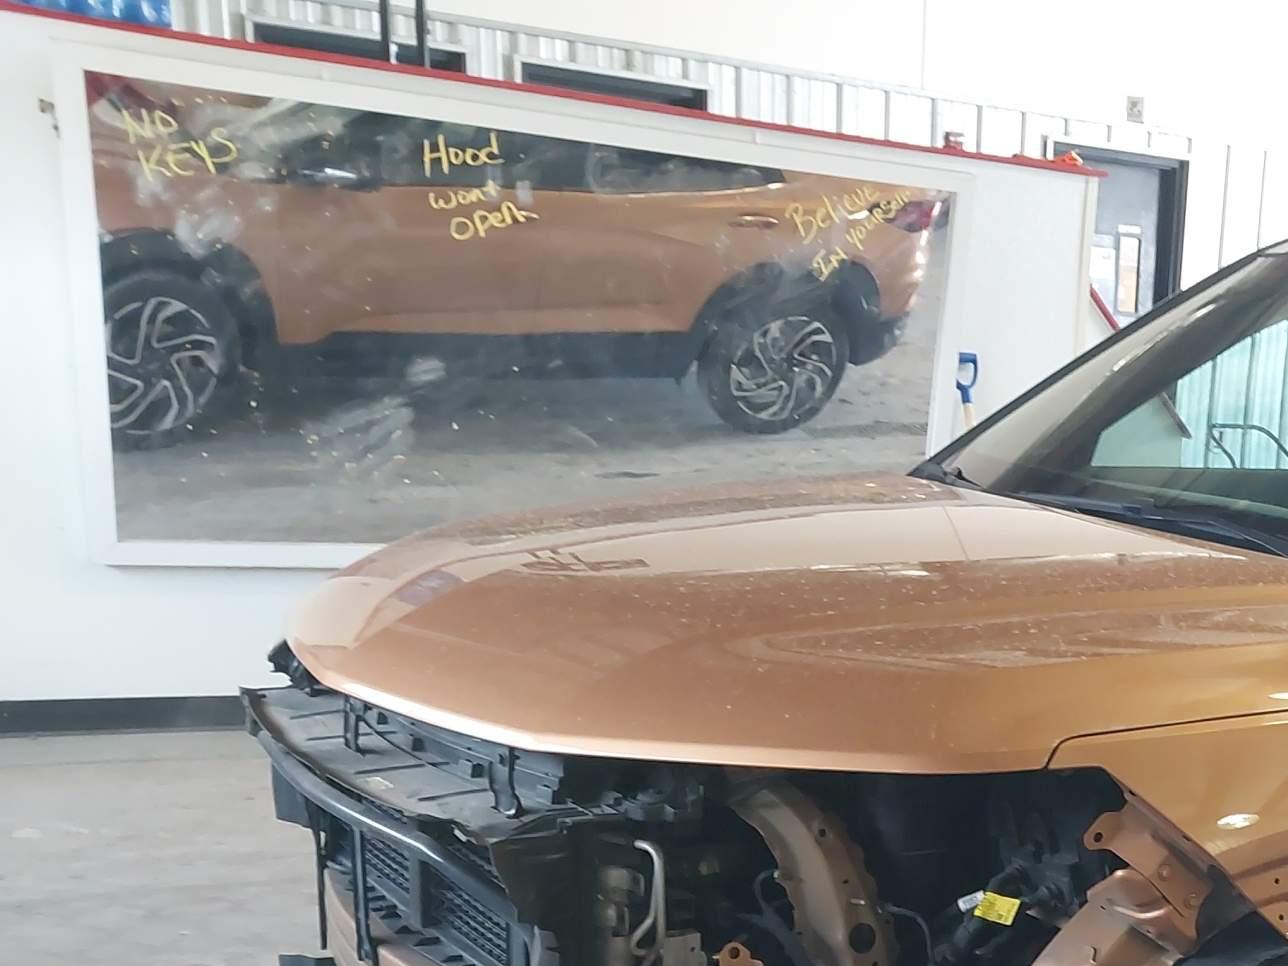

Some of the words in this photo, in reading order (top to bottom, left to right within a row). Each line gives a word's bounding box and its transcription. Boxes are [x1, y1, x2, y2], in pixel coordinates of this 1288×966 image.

[121, 108, 178, 144] NO
[137, 128, 238, 181] KEYS
[423, 131, 505, 178] Hood
